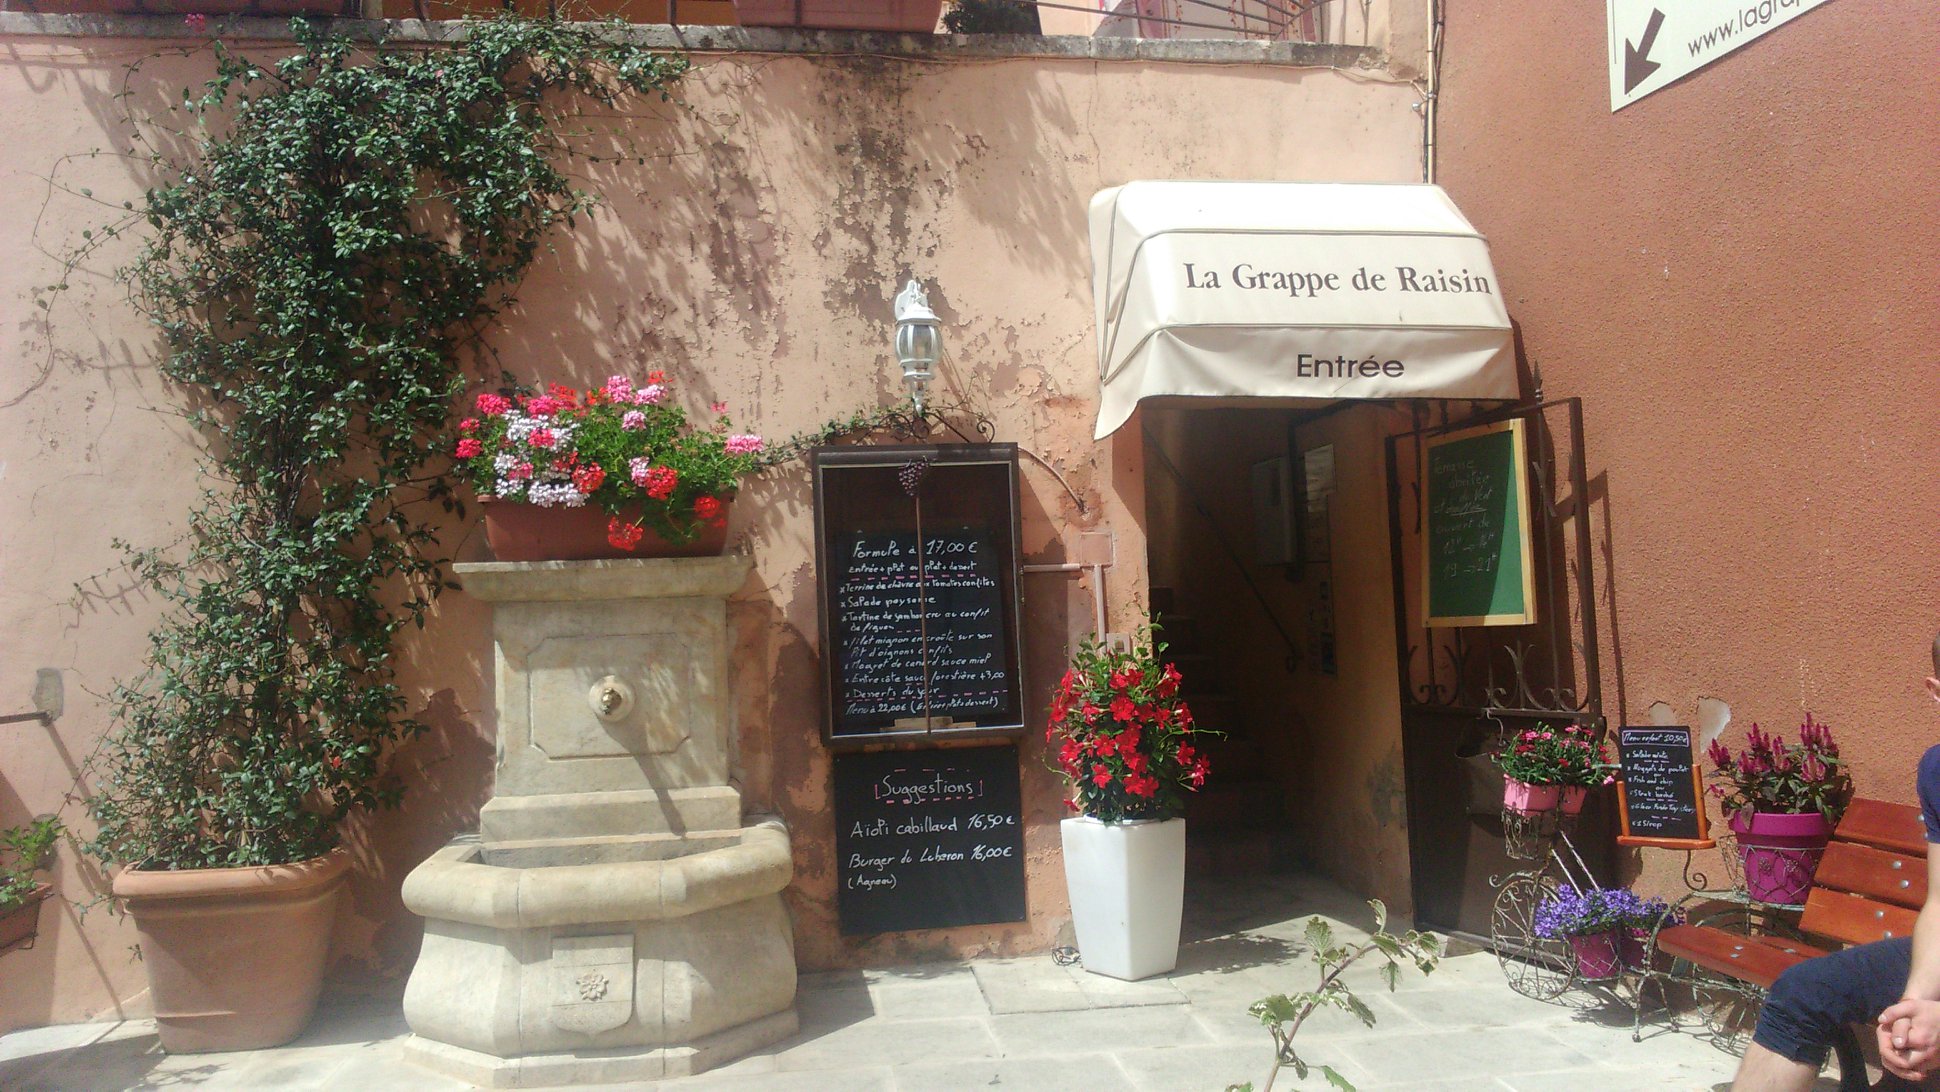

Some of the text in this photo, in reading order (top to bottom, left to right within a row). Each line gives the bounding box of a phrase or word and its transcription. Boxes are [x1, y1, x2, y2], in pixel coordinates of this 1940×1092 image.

[1183, 263, 1493, 298] La Grappe de Raisin
[1297, 354, 1405, 378] Entrée
[853, 540, 900, 558] Formule
[908, 546, 917, 554] à
[949, 560, 977, 571] dessert
[876, 582, 886, 590] de
[932, 579, 961, 588] tomates
[962, 577, 995, 589] confites
[849, 597, 882, 608] Salade
[847, 612, 880, 621] Tartine
[883, 612, 893, 620] de
[960, 608, 990, 620] confit
[850, 624, 861, 632] de
[875, 635, 909, 648] mignon
[927, 629, 955, 642] croûte
[958, 633, 974, 641] sur
[869, 647, 914, 660] d'oignons
[918, 645, 952, 657] cnfits
[852, 660, 889, 673] Magret
[891, 660, 901, 668] de
[941, 657, 966, 666] sauce
[930, 670, 976, 685] forestière
[853, 688, 897, 698] Desserts
[902, 686, 913, 695] du
[870, 704, 876, 713] à
[882, 773, 973, 805] Suggestions
[850, 818, 889, 838] Aïoli
[896, 816, 957, 834] cabillaud
[1643, 820, 1662, 829] Sirop
[849, 853, 895, 871] Burger
[900, 850, 912, 864] du
[920, 845, 963, 862] Luberon
